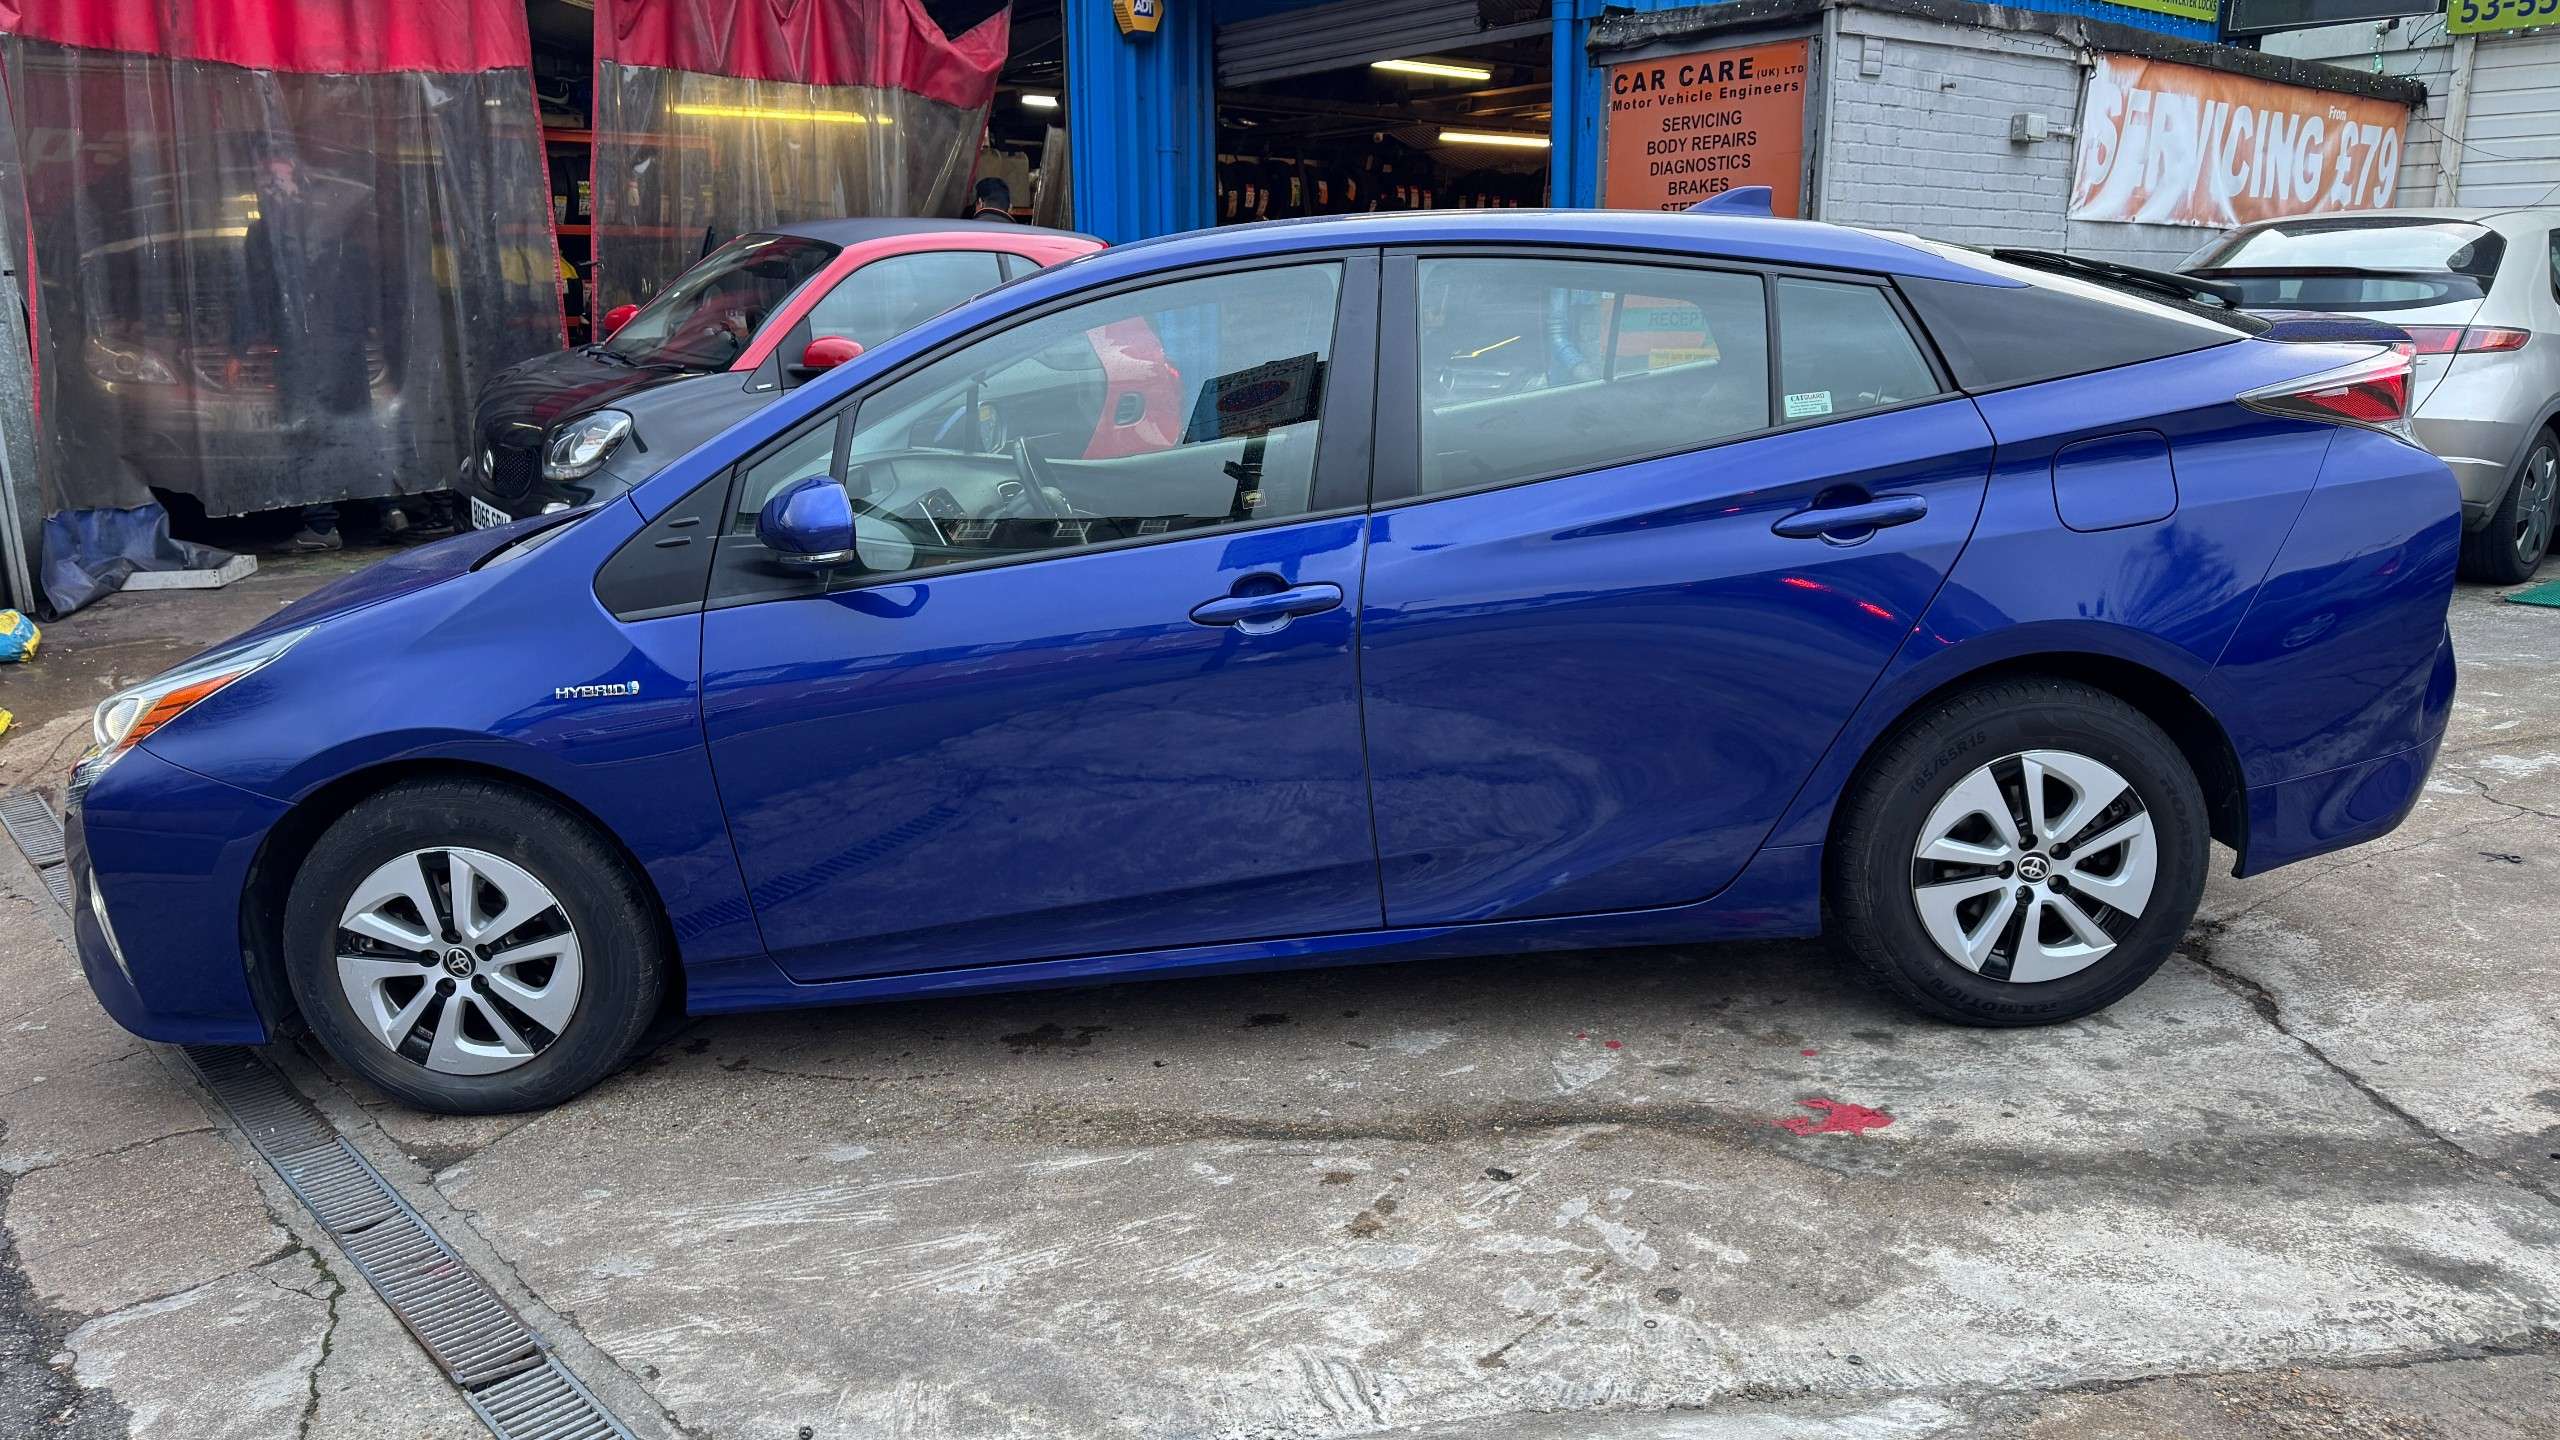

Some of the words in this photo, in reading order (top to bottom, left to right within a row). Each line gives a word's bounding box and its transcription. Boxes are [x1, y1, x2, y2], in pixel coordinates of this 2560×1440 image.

[1134, 0, 1154, 14] ADT
[1614, 69, 1666, 95] CAR
[1679, 57, 1754, 87] CARE
[1757, 67, 1780, 79] (UK)
[1784, 64, 1805, 75] LTD
[1612, 98, 1652, 112] Motor
[1658, 90, 1713, 107] Vehicle
[1719, 81, 1800, 100] Engineers
[1662, 110, 1742, 133] SERVICING
[2328, 105, 2347, 120] From
[1647, 137, 1688, 155] BODY
[1691, 131, 1757, 152] REPAIRS
[2084, 82, 2324, 203] SERVICING
[2331, 121, 2398, 208] £79
[1650, 153, 1751, 176] DIAGNOSTICS
[1668, 177, 1729, 196] BRAKES
[1650, 311, 1704, 329] RECEP
[555, 684, 626, 699] HYBRID
